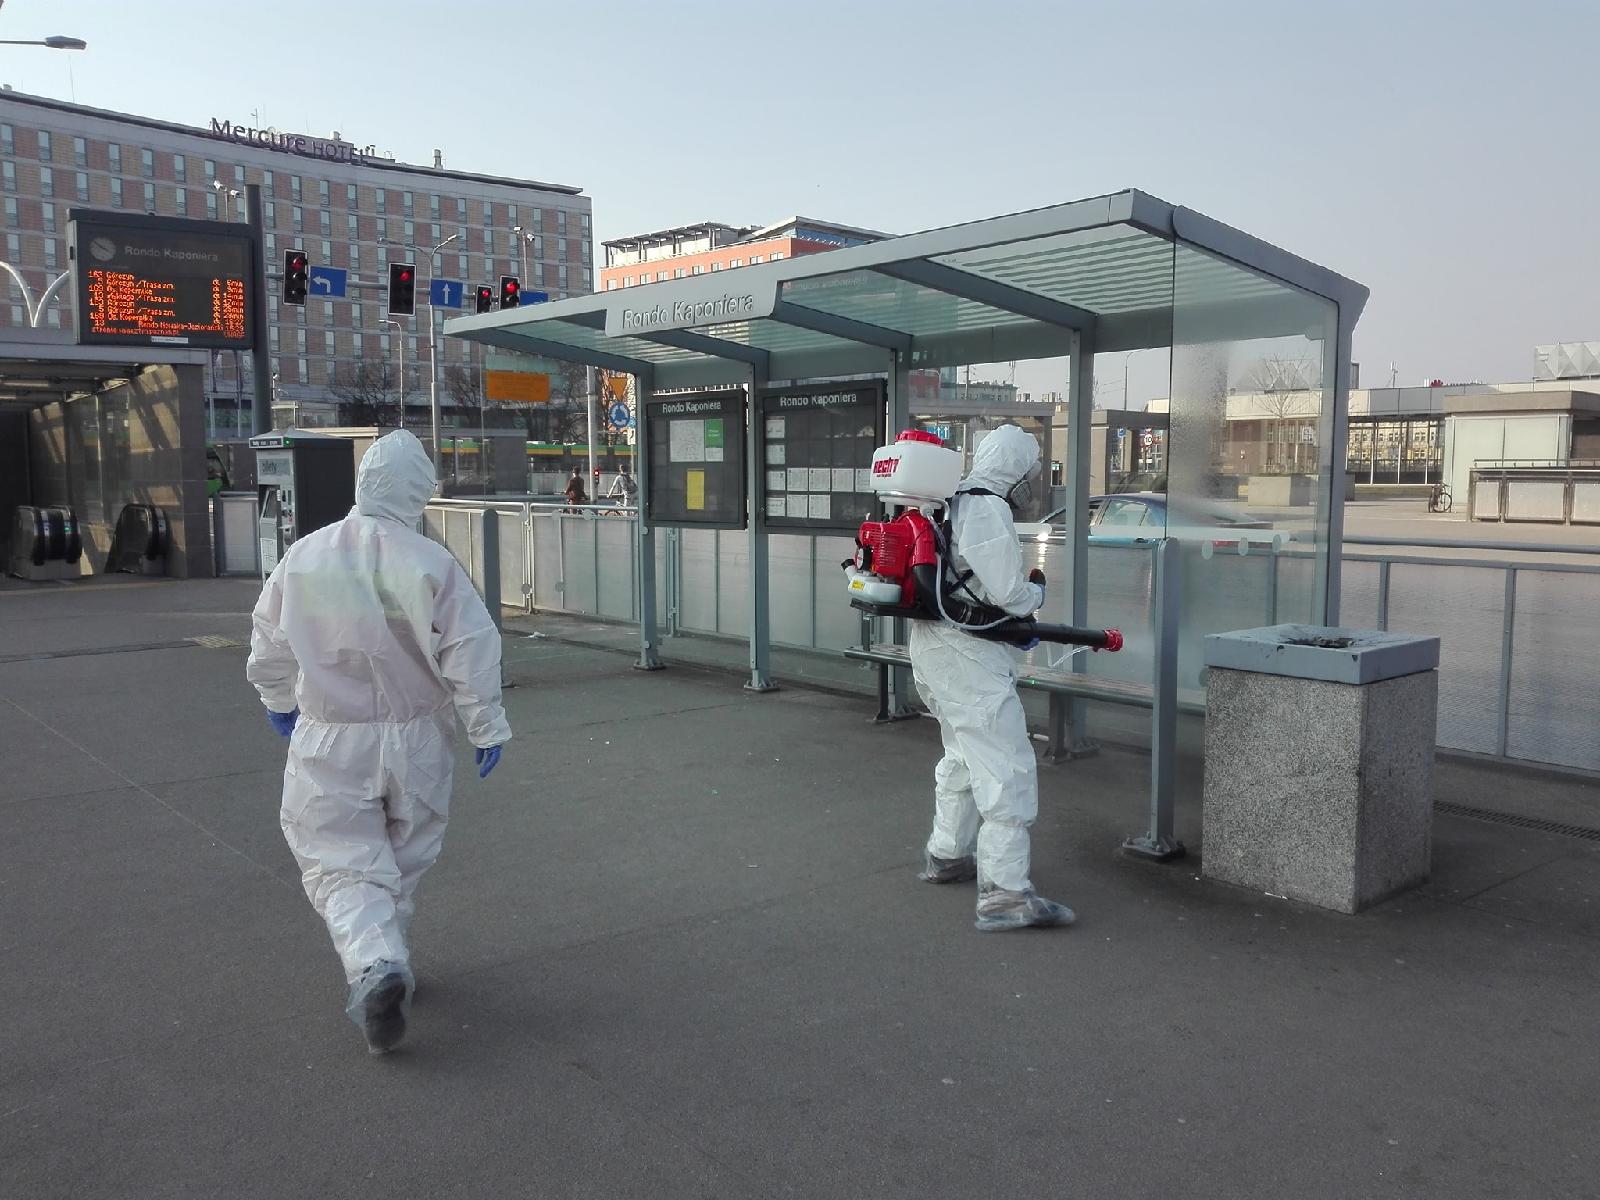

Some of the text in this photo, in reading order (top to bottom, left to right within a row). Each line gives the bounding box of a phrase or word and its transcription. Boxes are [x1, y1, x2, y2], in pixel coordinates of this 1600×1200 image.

[210, 117, 306, 153] Mercure
[124, 245, 219, 262] Rondo Kaponiera
[622, 293, 754, 329] Rondo Kaponiera
[662, 400, 722, 414] Rondo Kaponiera
[780, 391, 857, 407] Rondo Kaponiera
